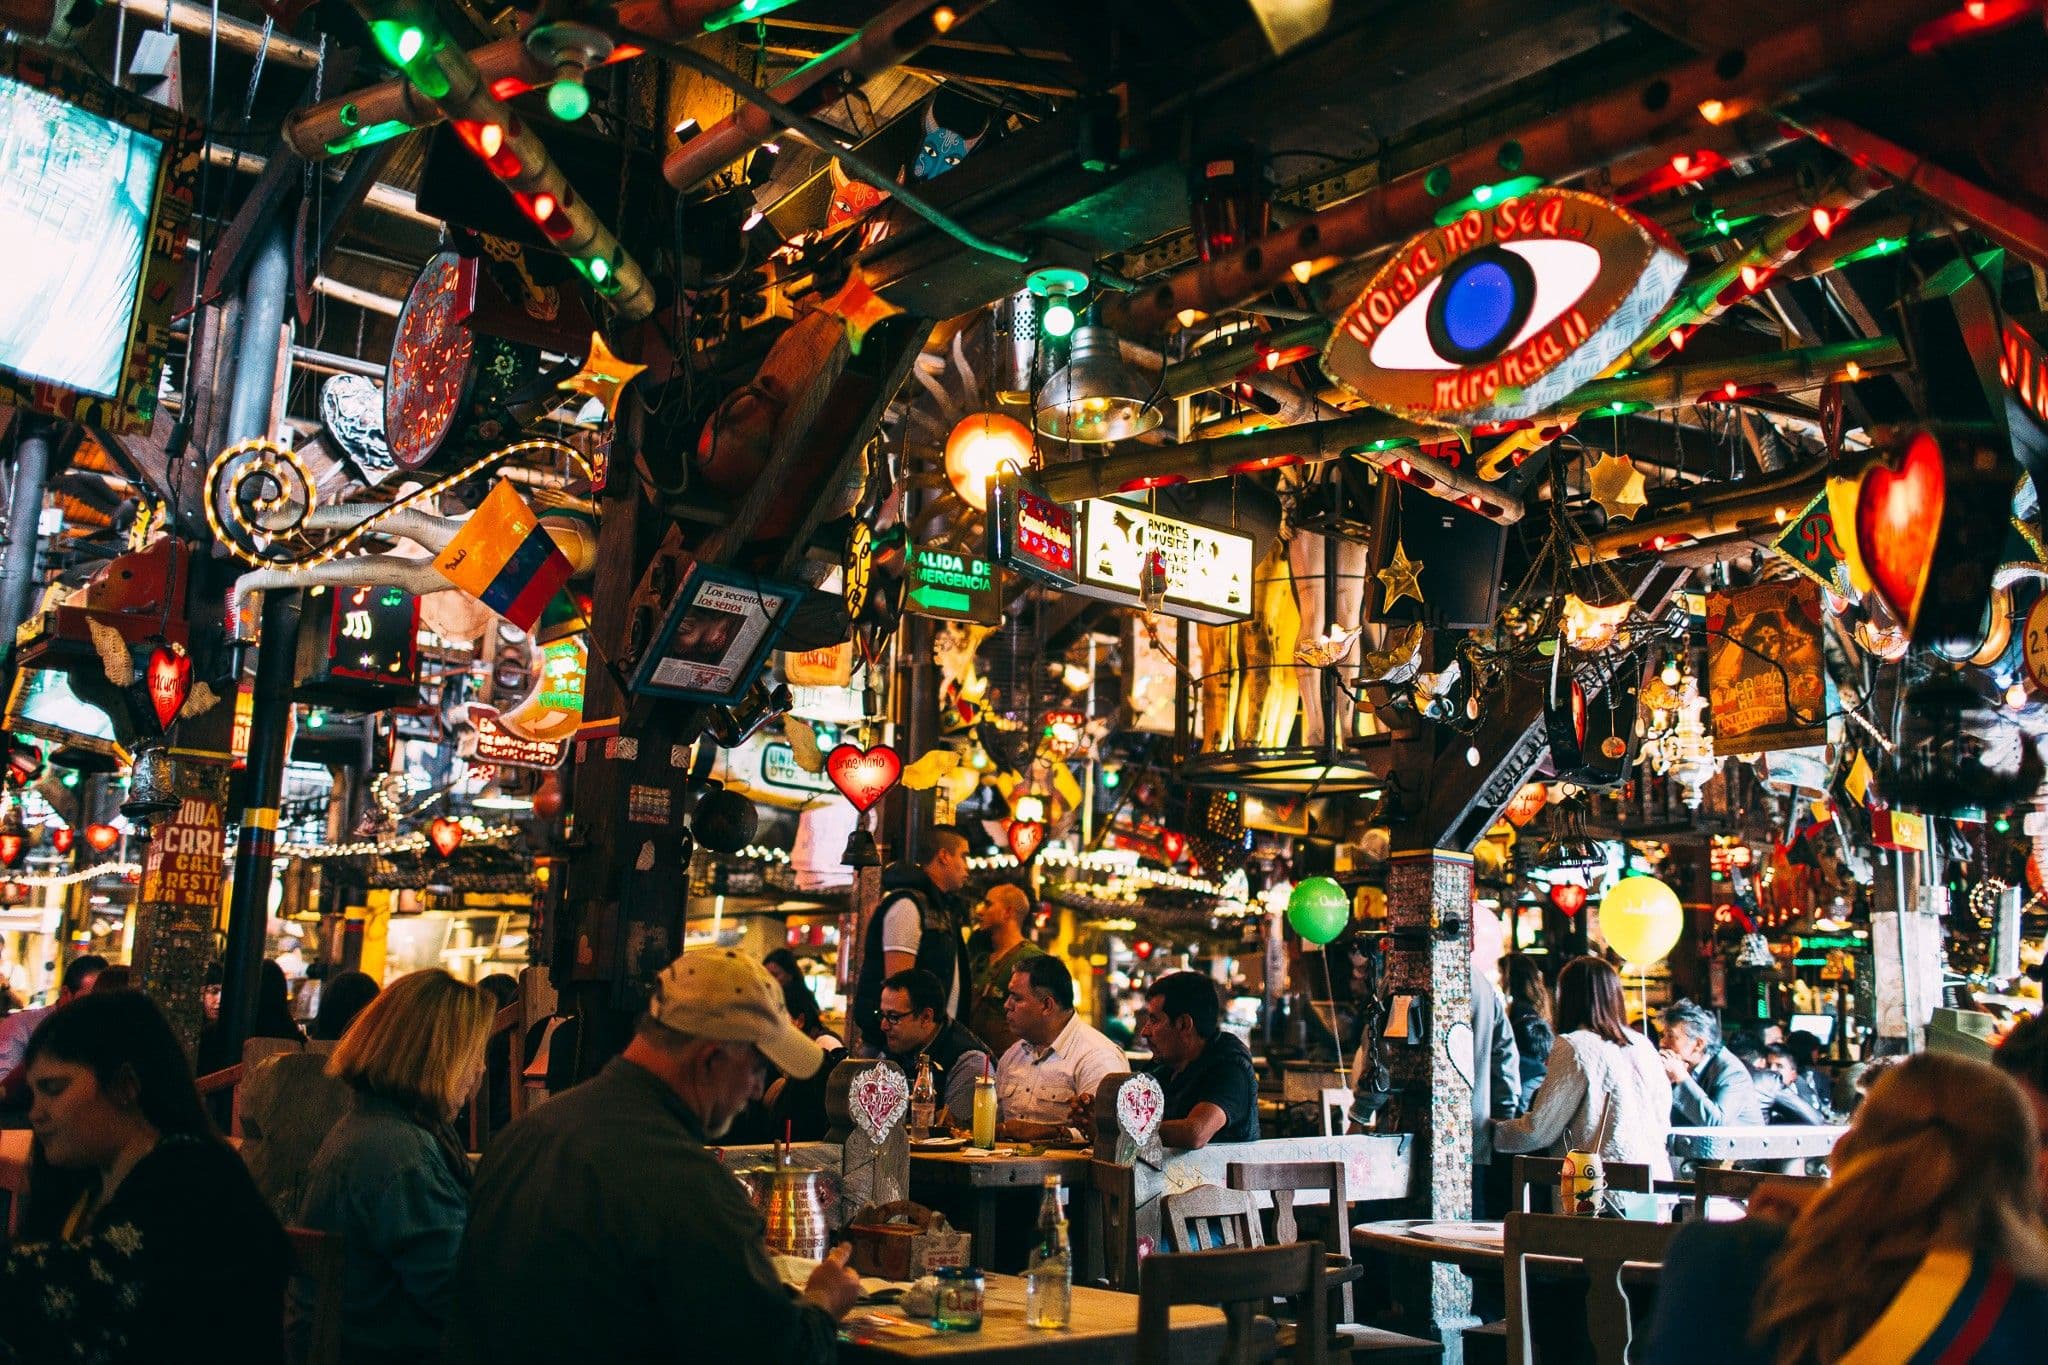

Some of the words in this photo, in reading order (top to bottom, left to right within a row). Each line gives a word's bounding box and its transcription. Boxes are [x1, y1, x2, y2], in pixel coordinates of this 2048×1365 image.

[917, 551, 963, 572] ALIDA
[972, 560, 991, 576] DE
[698, 595, 714, 606] los
[714, 600, 744, 613] senos
[705, 585, 722, 597] Los
[764, 598, 777, 608] de
